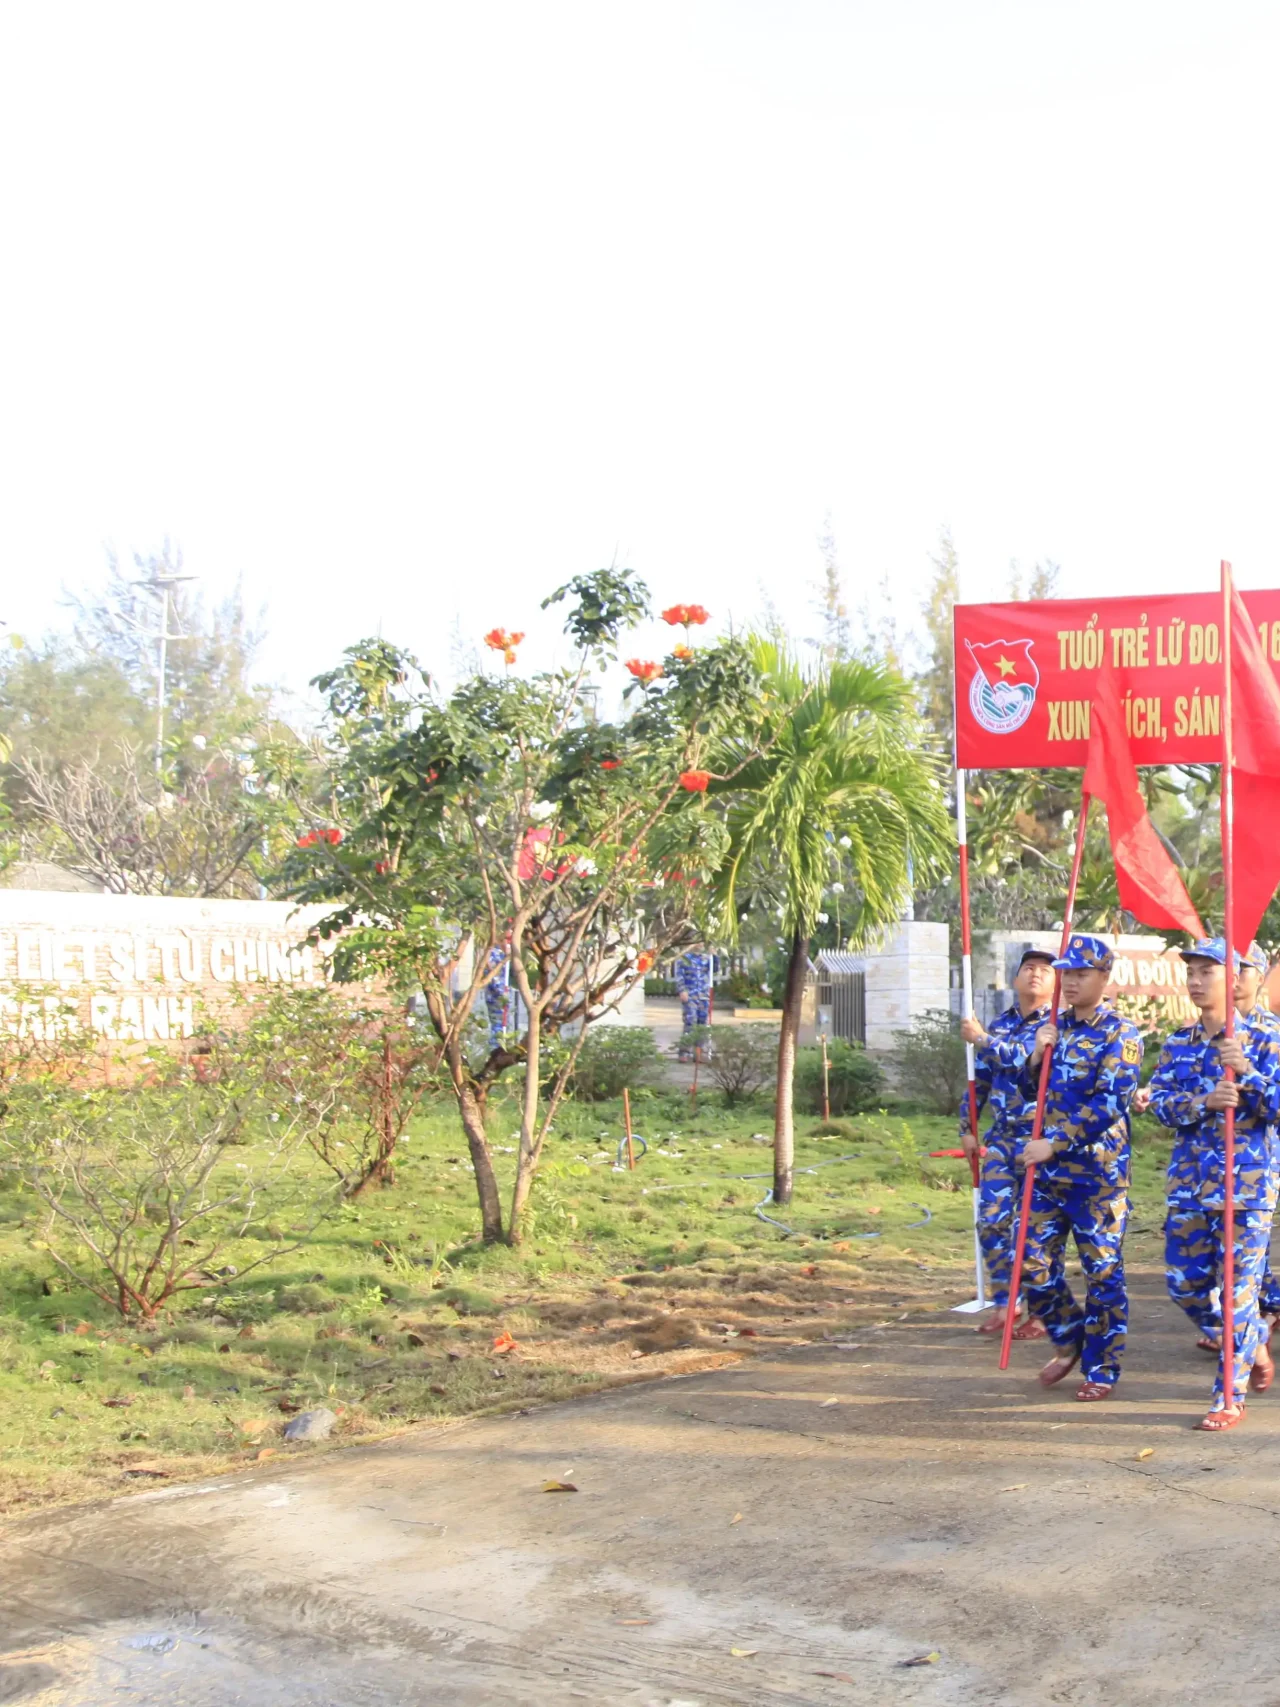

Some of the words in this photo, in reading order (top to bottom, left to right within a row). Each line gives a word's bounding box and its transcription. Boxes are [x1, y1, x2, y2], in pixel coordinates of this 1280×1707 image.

[1057, 613, 1104, 670] TUỔI
[1110, 613, 1149, 668] TRẺ
[1156, 617, 1186, 667] LỮ
[1189, 623, 1223, 665] ĐO
[1047, 700, 1094, 742] XUN
[1121, 689, 1168, 743] ÍCH,
[1174, 686, 1223, 738] SÁN
[91, 995, 194, 1040] RANH
